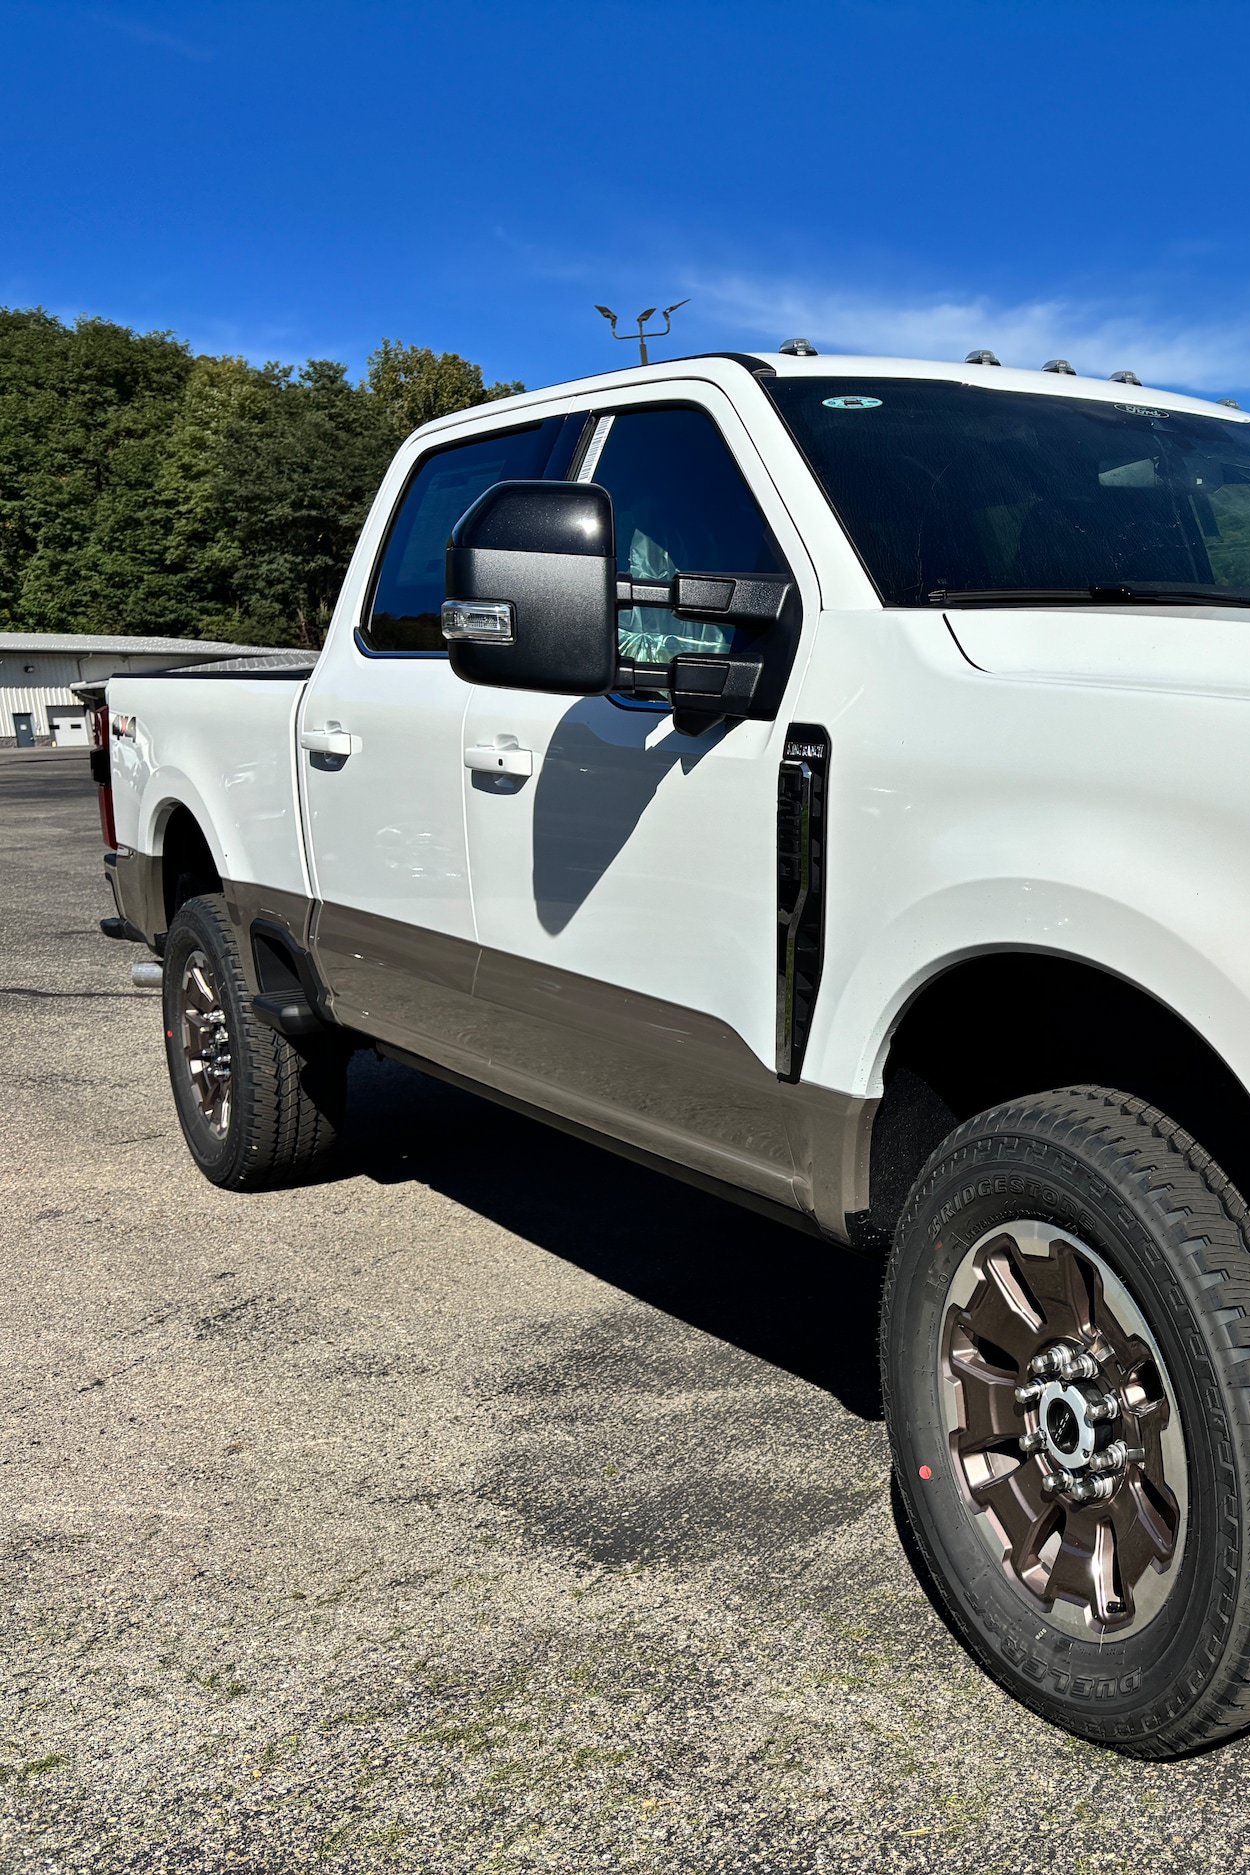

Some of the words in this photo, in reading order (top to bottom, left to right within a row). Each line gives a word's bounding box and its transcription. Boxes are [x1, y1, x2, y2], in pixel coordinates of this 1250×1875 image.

[1125, 405, 1161, 416] Ford
[927, 1174, 1097, 1240] BRIDGESTONE
[1001, 1634, 1143, 1700] DUELER
